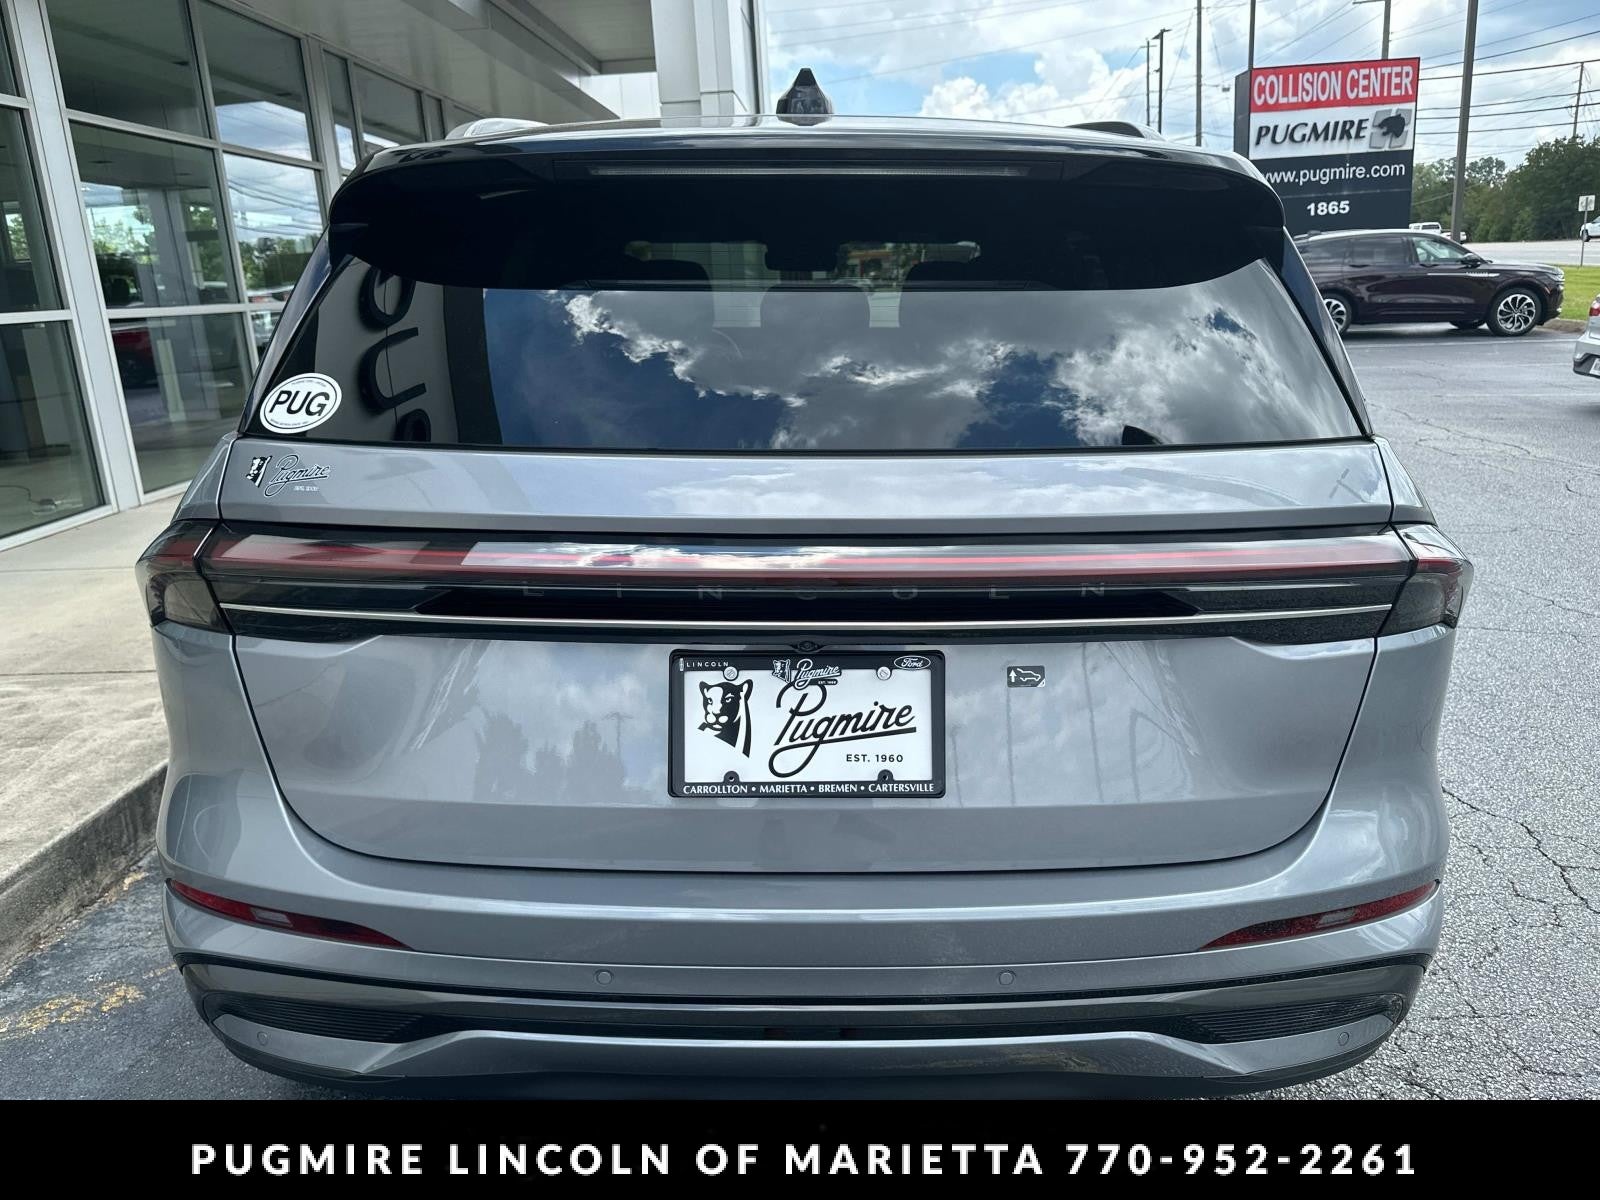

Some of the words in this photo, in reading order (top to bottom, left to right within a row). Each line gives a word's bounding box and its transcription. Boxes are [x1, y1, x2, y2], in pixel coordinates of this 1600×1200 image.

[1253, 70, 1341, 106] COLLISION
[1346, 65, 1413, 100] CENTER
[1255, 118, 1369, 146] PUGMIRE
[1265, 163, 1405, 186] ww.pugmire.com
[1307, 200, 1350, 216] 1865
[268, 389, 330, 417] PUG
[264, 454, 331, 497] Pugmire
[795, 658, 841, 690] Pugmire
[901, 657, 924, 668] Ford
[768, 683, 917, 778] Pugmire
[846, 753, 870, 763] EST.
[875, 753, 904, 763] 1960
[683, 785, 748, 794] CARROLLTON
[759, 784, 808, 793] MARIETTA
[818, 783, 858, 793] BREMEN
[868, 783, 934, 792] CARTERSVILLE
